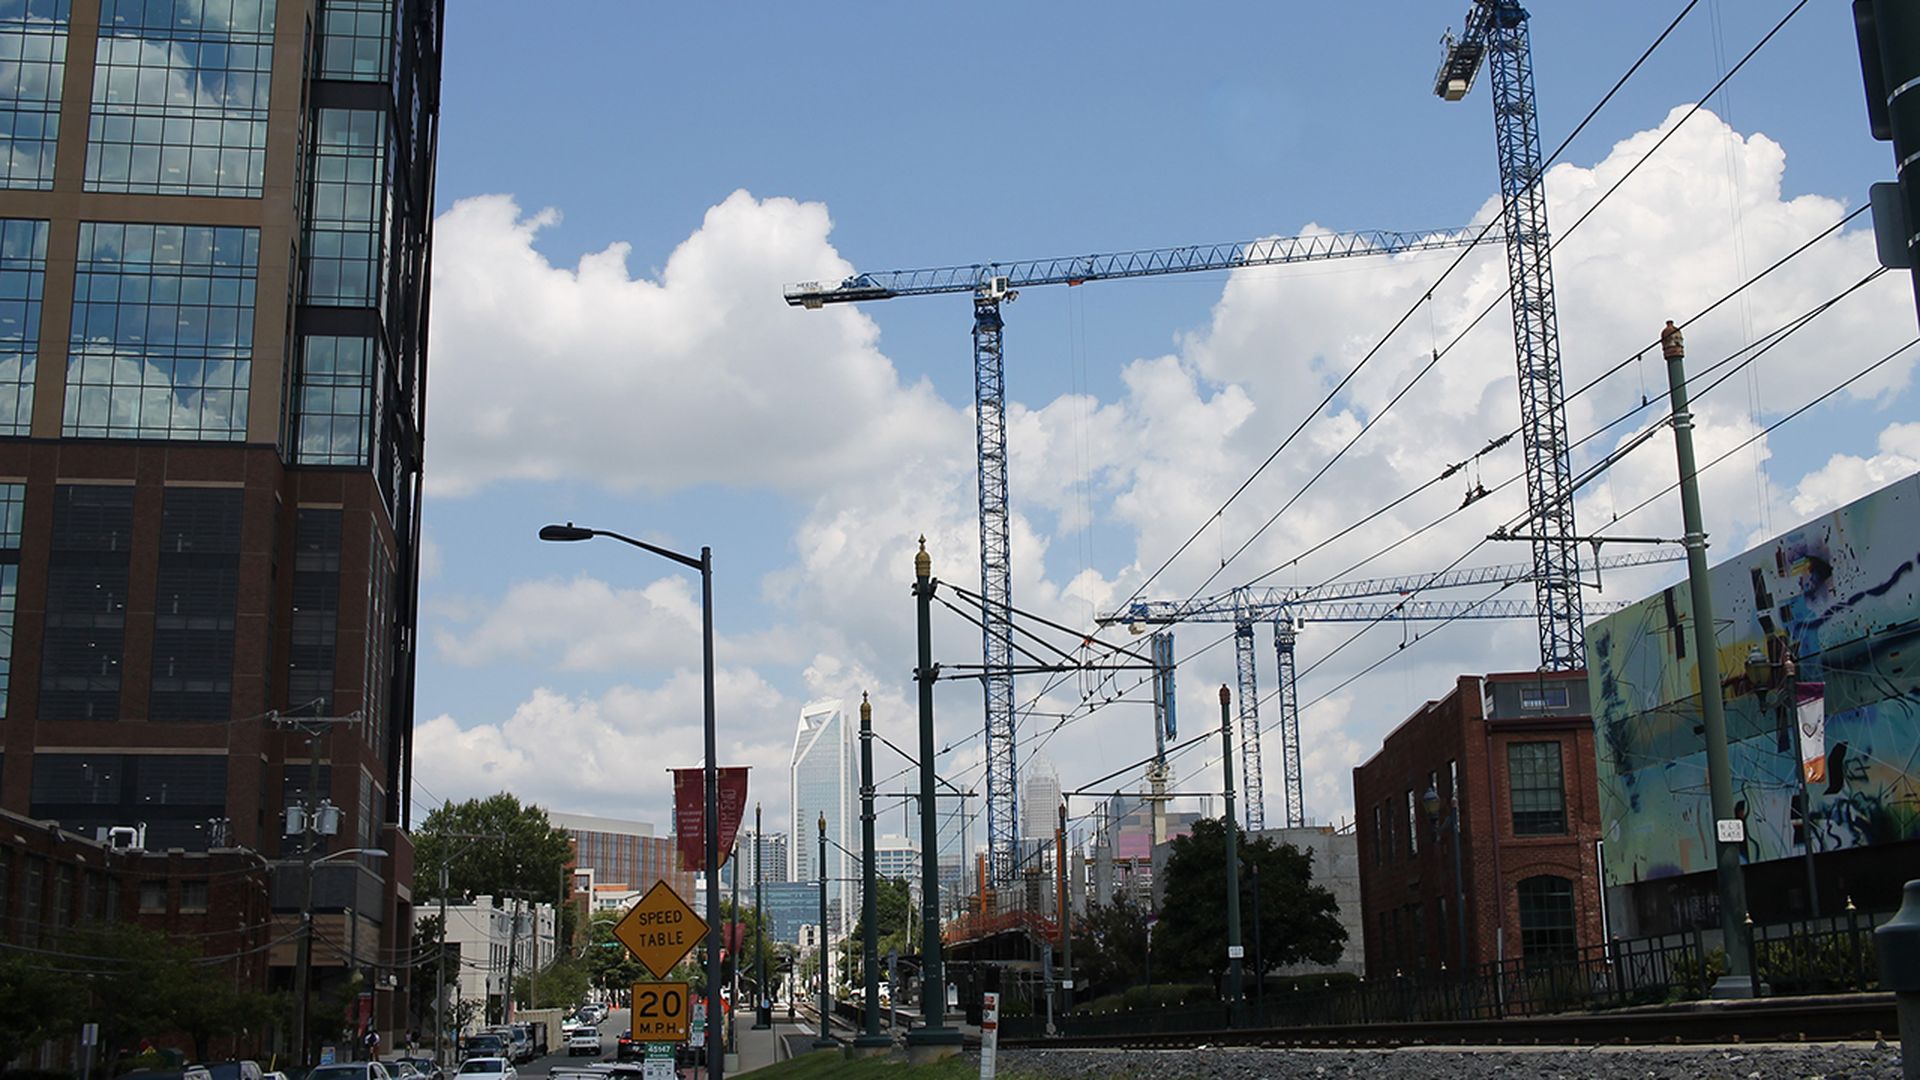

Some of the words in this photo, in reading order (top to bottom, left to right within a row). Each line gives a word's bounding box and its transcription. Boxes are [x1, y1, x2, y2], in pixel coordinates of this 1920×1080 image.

[639, 910, 682, 926] SPEED
[639, 931, 684, 947] TABLE
[640, 991, 681, 1017] 20
